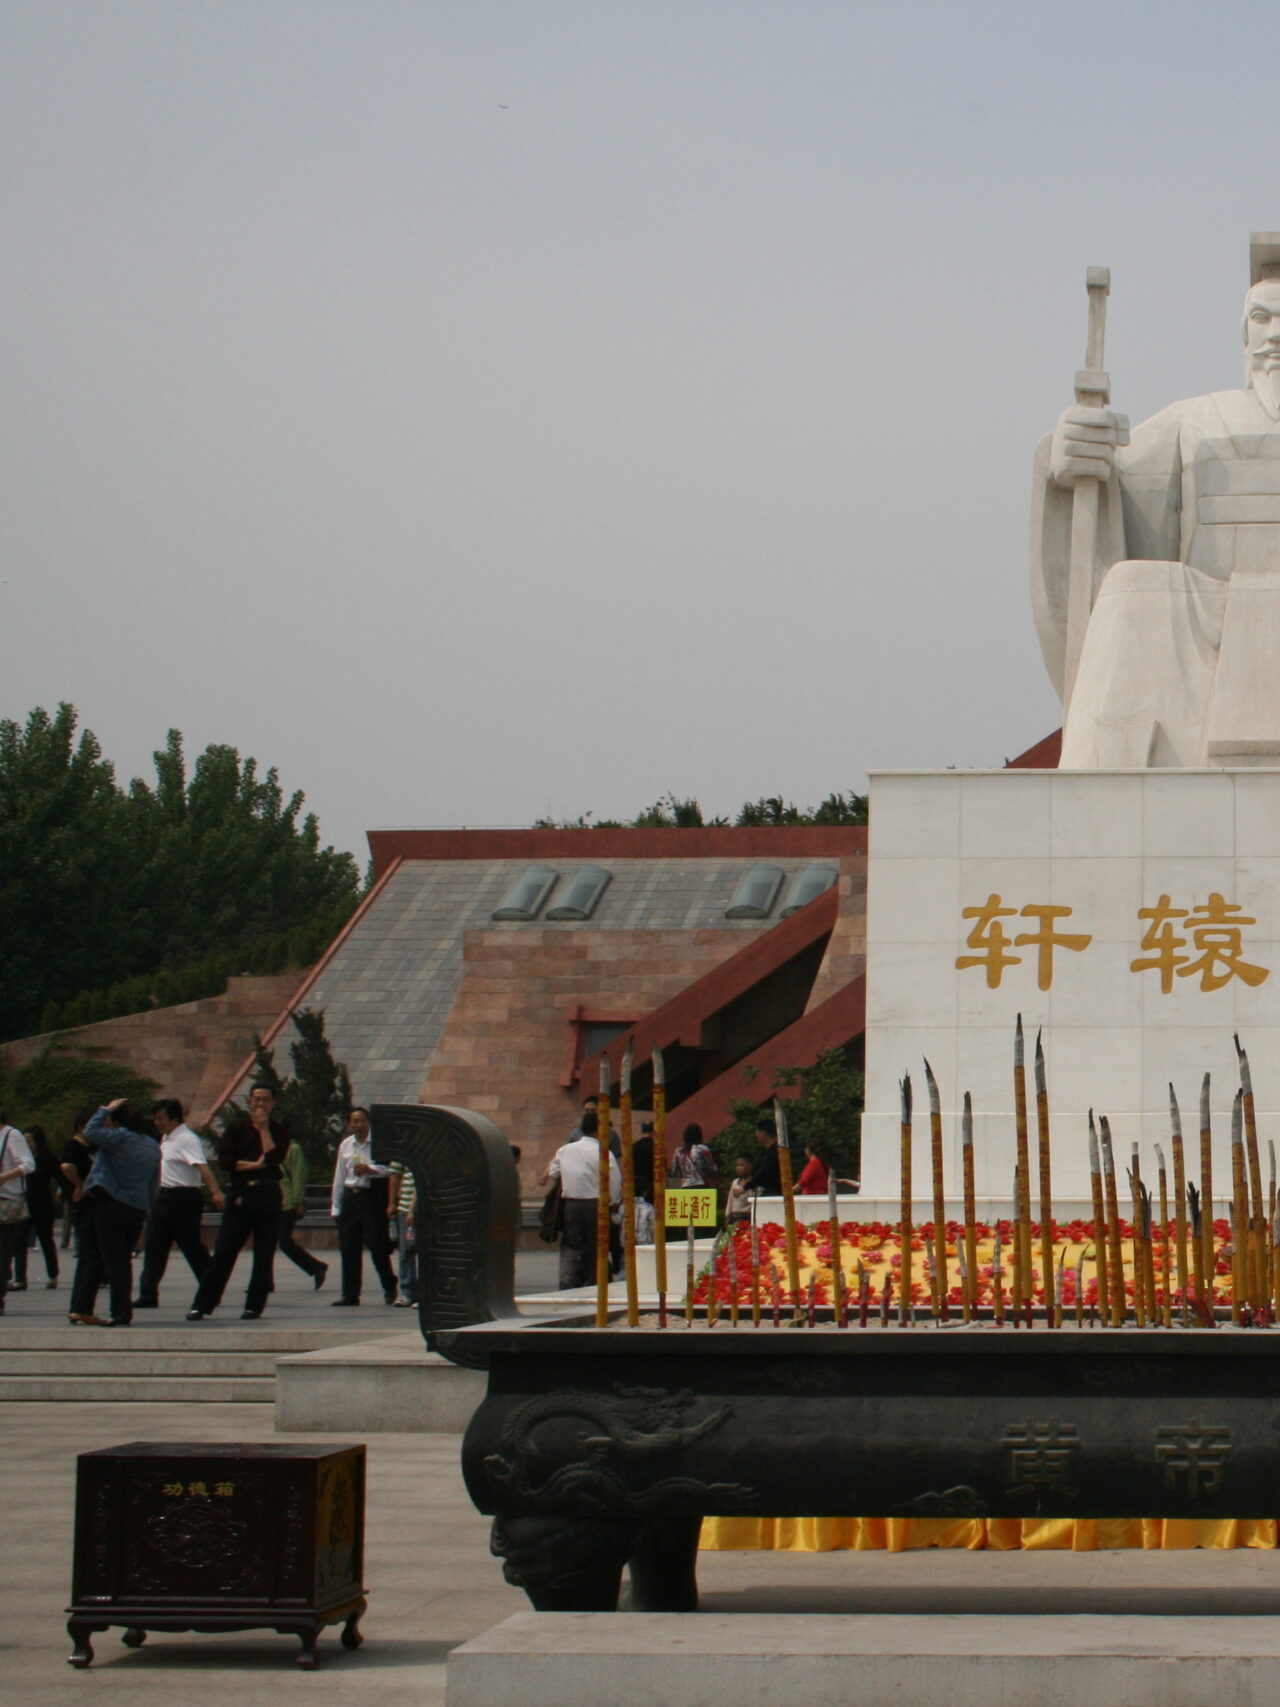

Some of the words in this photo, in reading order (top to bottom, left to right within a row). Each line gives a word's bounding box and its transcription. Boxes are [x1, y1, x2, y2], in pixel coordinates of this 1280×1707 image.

[668, 1195, 711, 1220] 禁止通行
[161, 1481, 236, 1498] 功德箱
